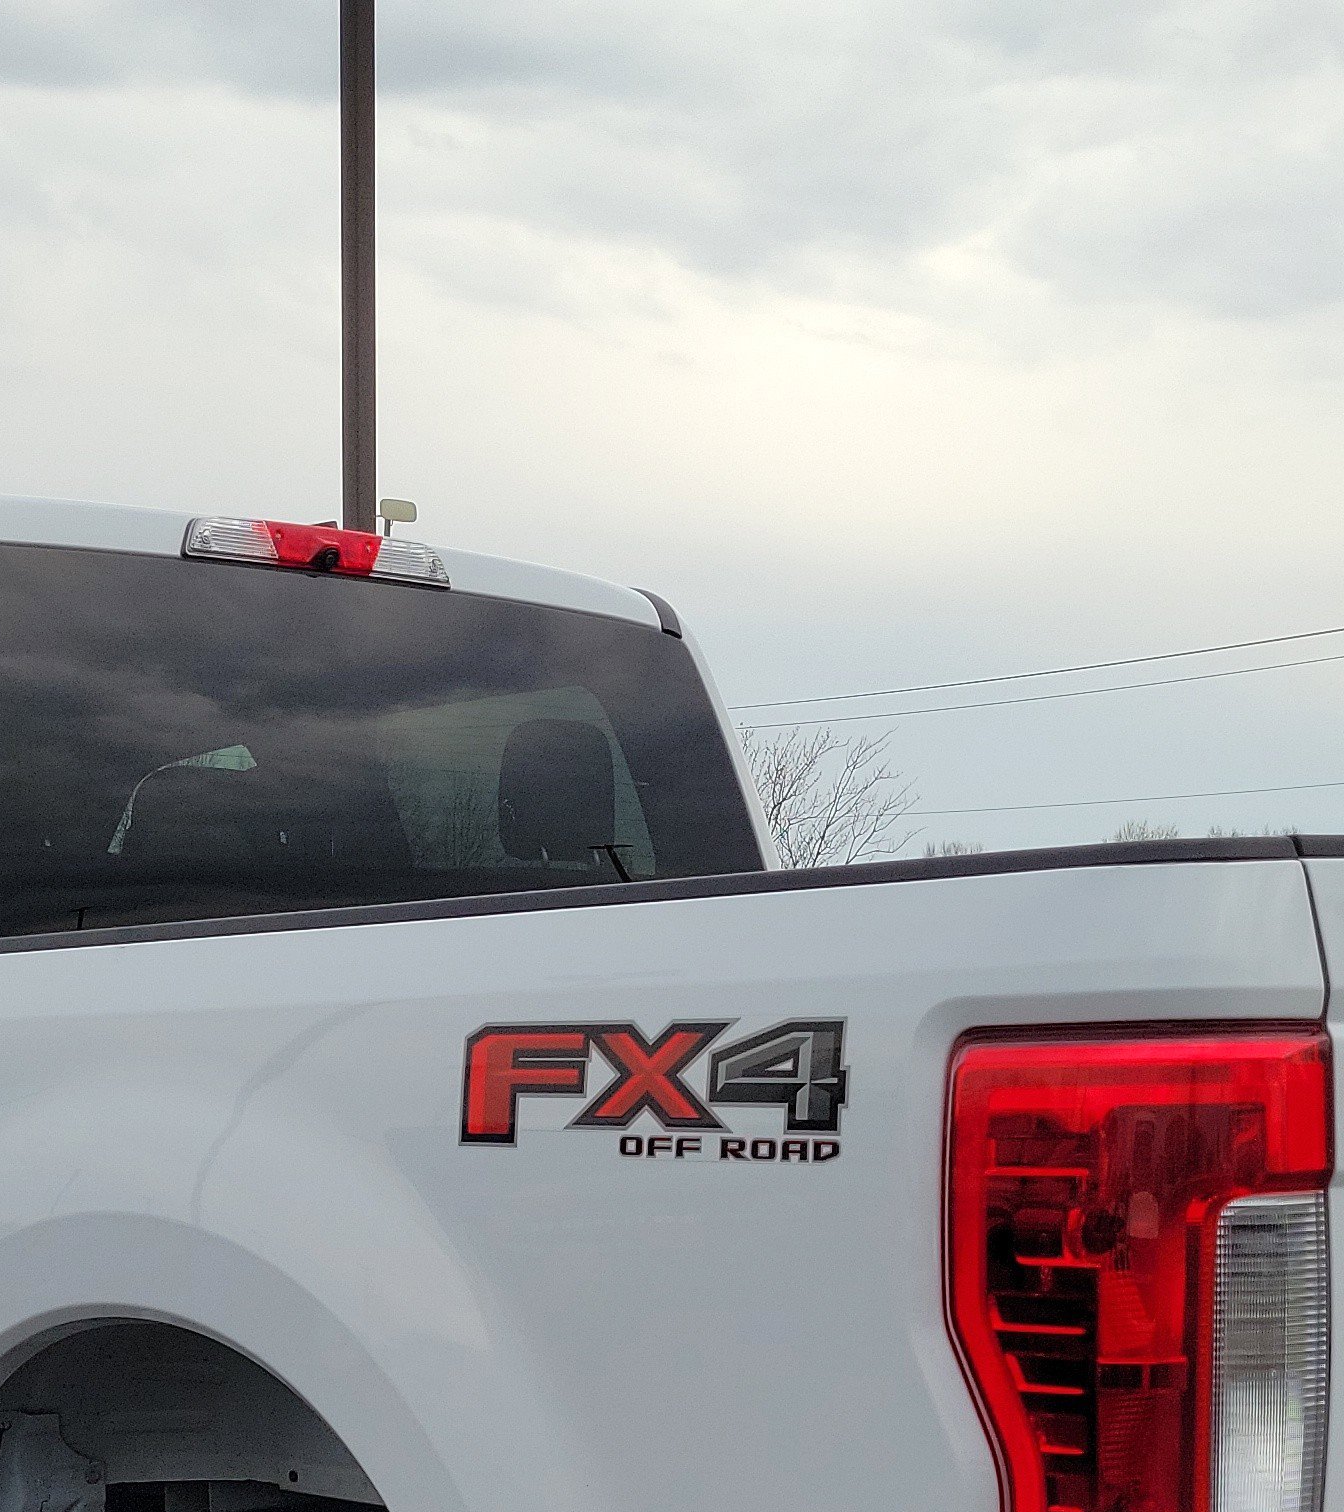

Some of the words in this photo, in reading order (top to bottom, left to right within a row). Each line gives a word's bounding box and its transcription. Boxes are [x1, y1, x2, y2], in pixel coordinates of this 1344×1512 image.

[459, 1017, 850, 1147] FX4
[619, 1135, 702, 1160] OFF
[720, 1137, 840, 1163] ROAD
